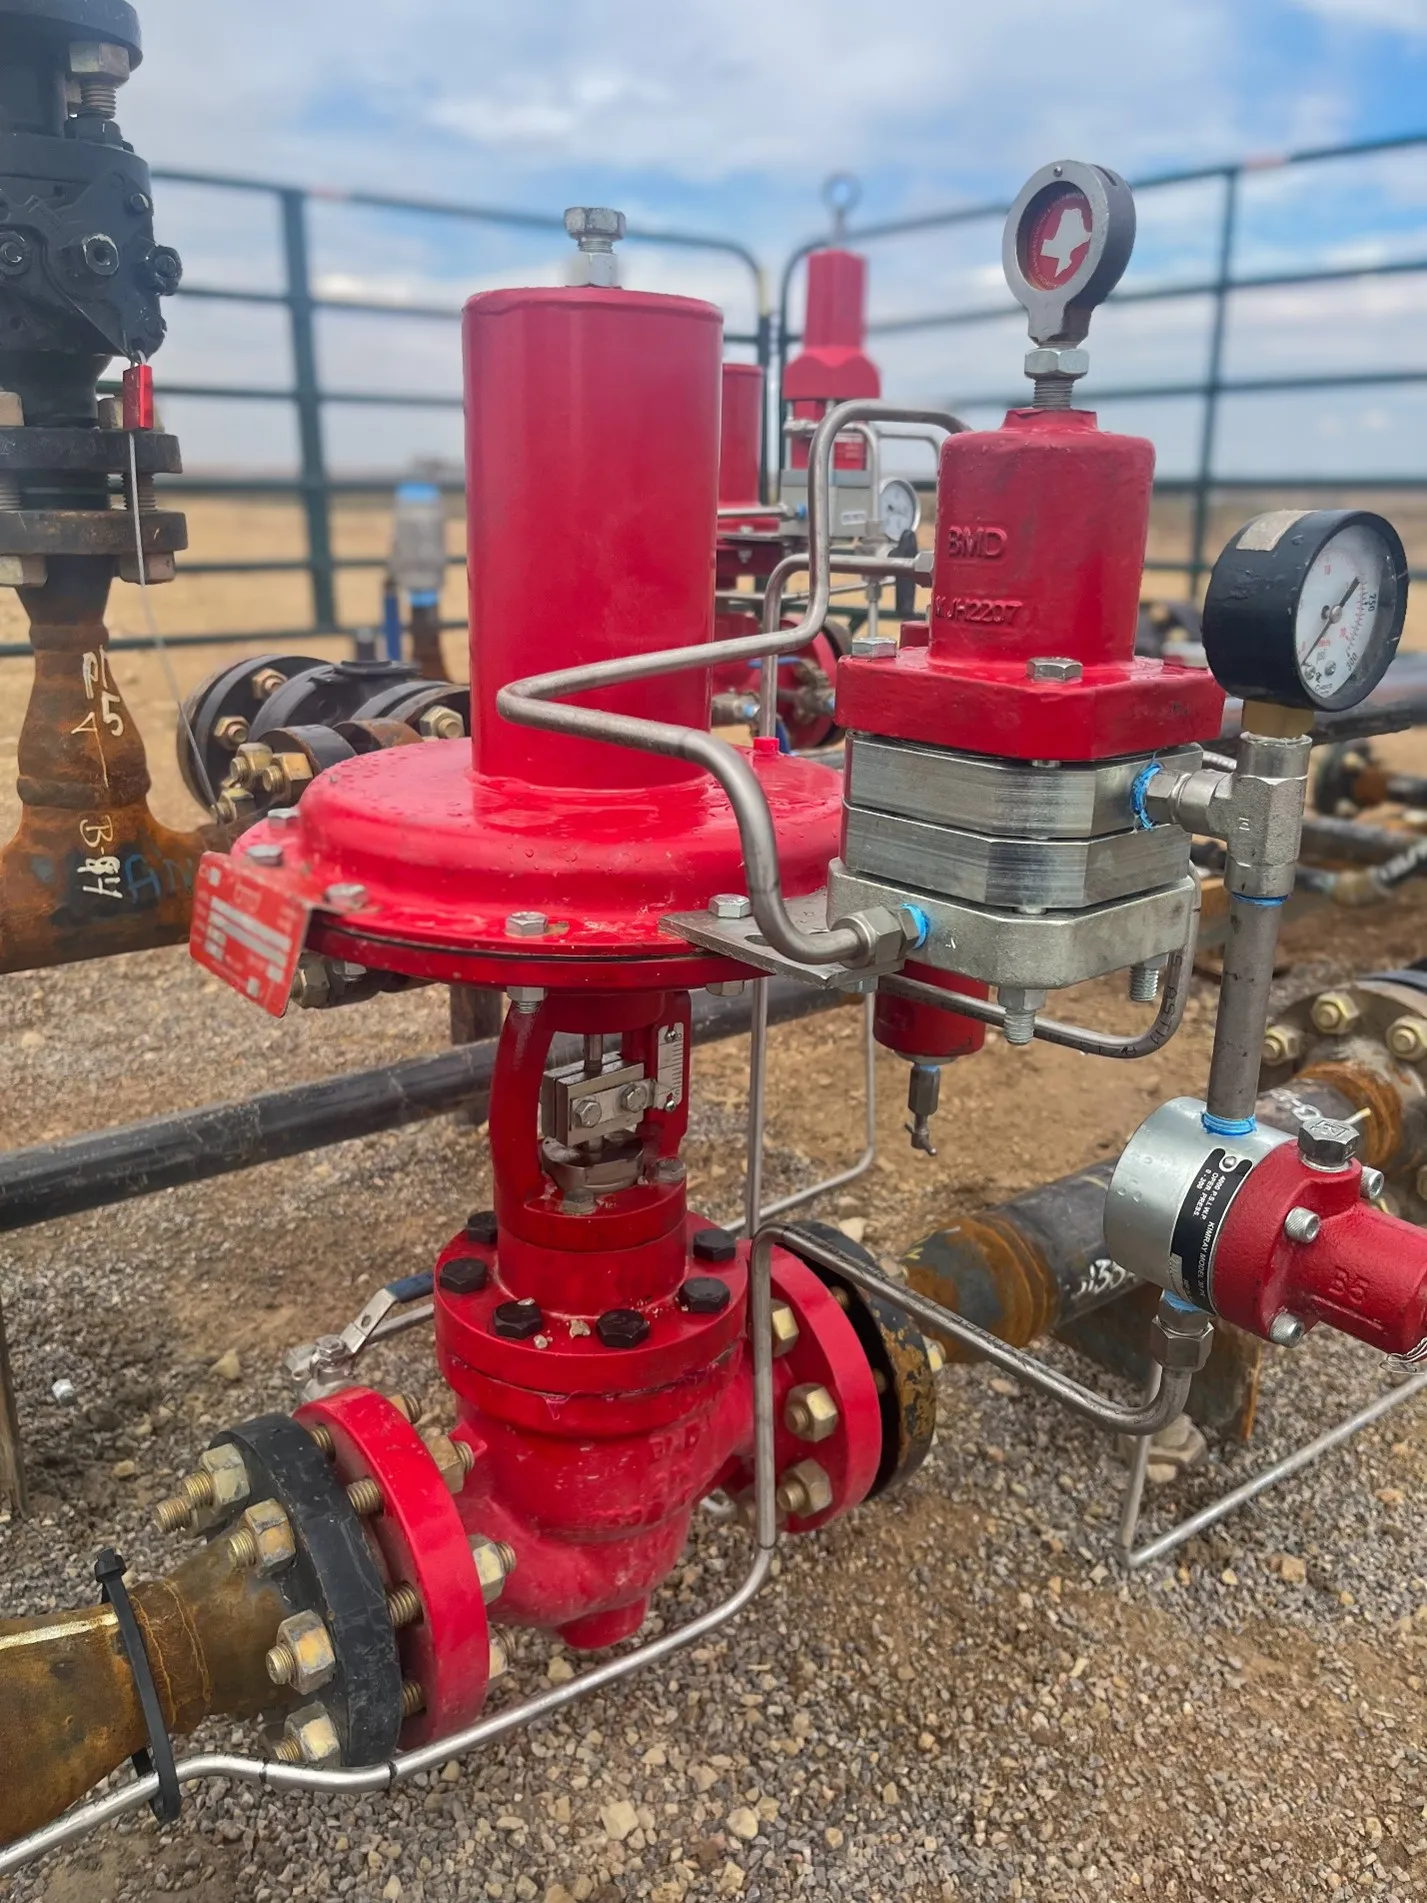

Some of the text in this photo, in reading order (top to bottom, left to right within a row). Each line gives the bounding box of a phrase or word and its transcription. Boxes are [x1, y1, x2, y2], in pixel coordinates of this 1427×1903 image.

[949, 525, 1007, 558] BMD
[1368, 593, 1377, 612] 250
[1193, 1192, 1208, 1216] PRESS.
[1201, 1221, 1215, 1253] KIMRAY
[1197, 1252, 1206, 1278] MODEL
